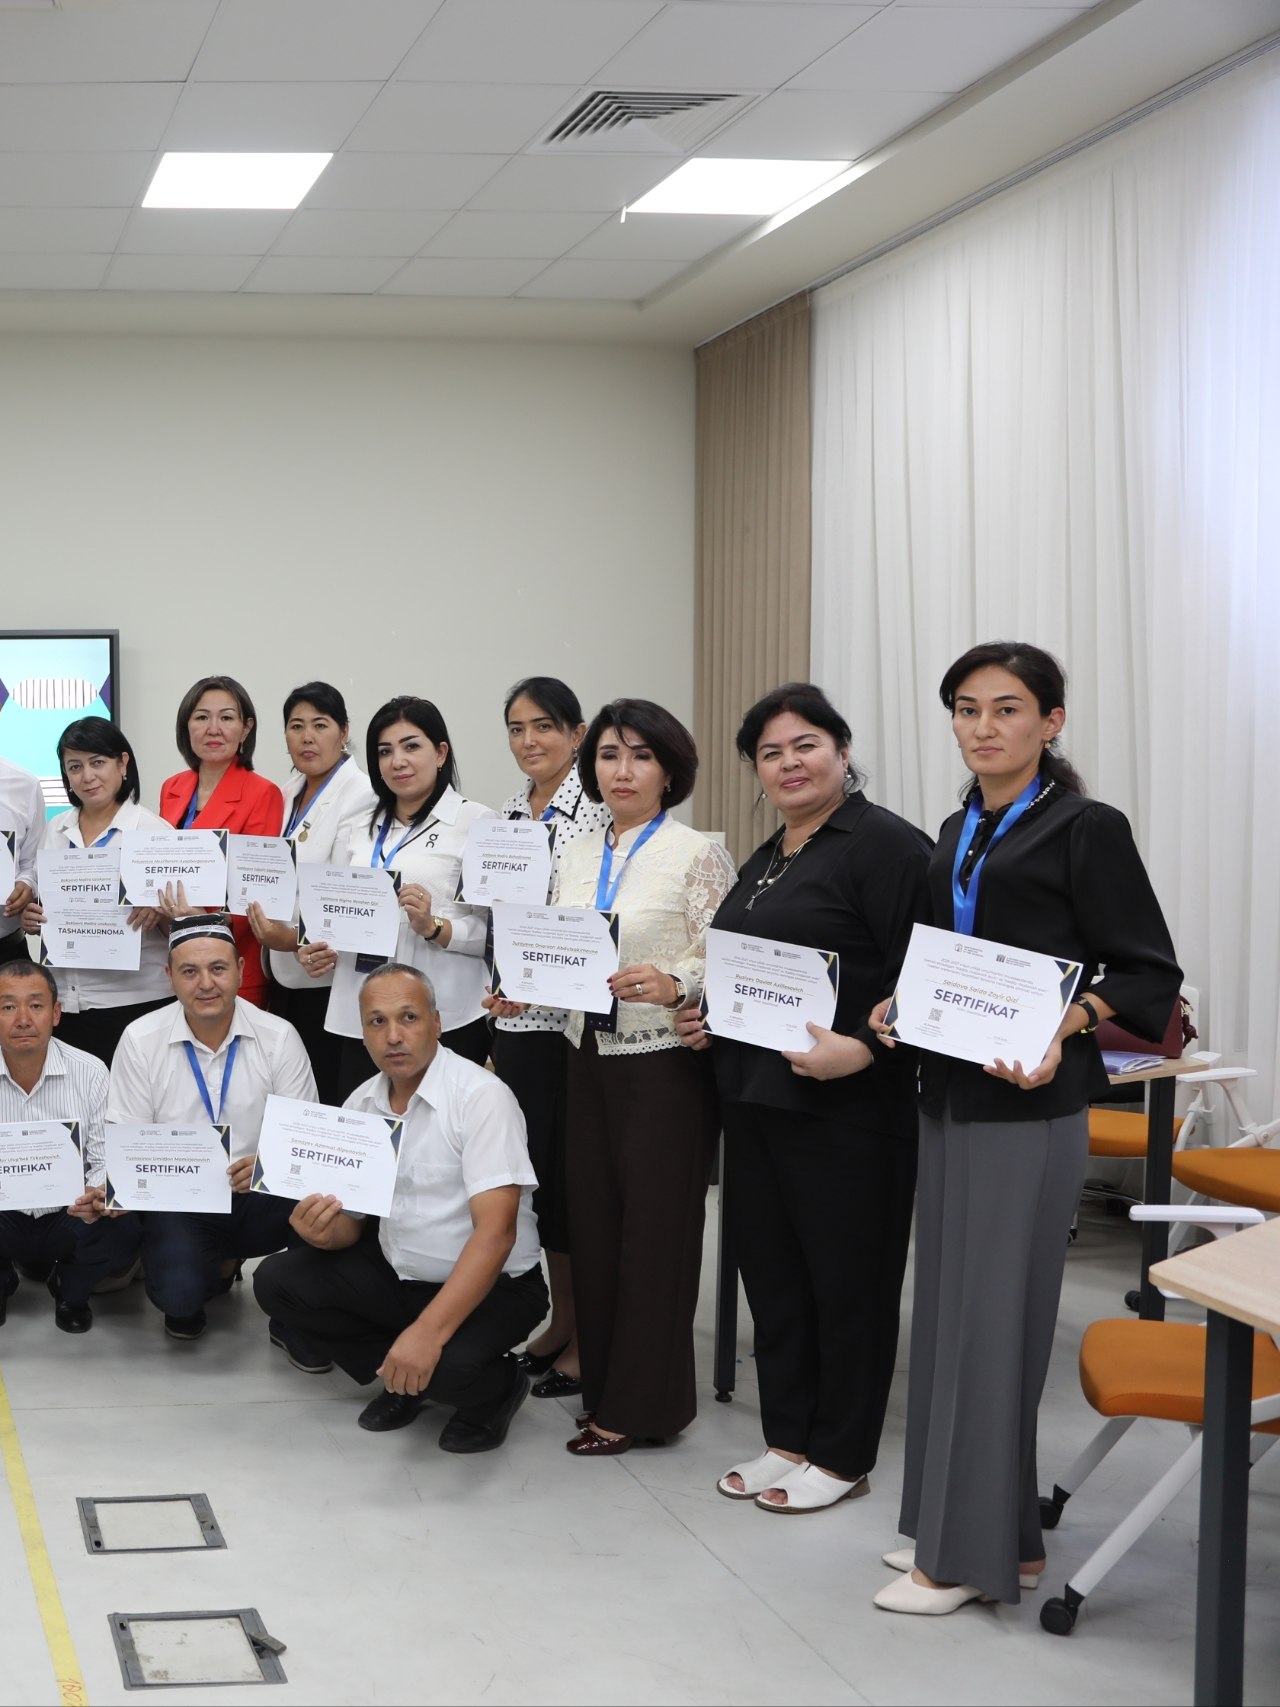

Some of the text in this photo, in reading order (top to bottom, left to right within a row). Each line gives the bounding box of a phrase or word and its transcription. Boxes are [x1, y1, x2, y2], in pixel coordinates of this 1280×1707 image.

[145, 866, 201, 874] SERTIFIKAT
[481, 860, 528, 872] SERTIFIKAT
[242, 873, 280, 884] SERTIFIKAT
[60, 884, 111, 892] SERTIFIKAT
[323, 906, 375, 917] SERTIFIKAT
[58, 927, 125, 936] TASHAKKURNOMA
[522, 951, 587, 967] SERTIFIKAT
[734, 984, 803, 1007] SERTIFIKAT
[933, 988, 1020, 1020] SERTIFIKAT
[291, 1147, 363, 1169] SERTIFIKAT
[135, 1164, 200, 1174] SERTIFIKAT
